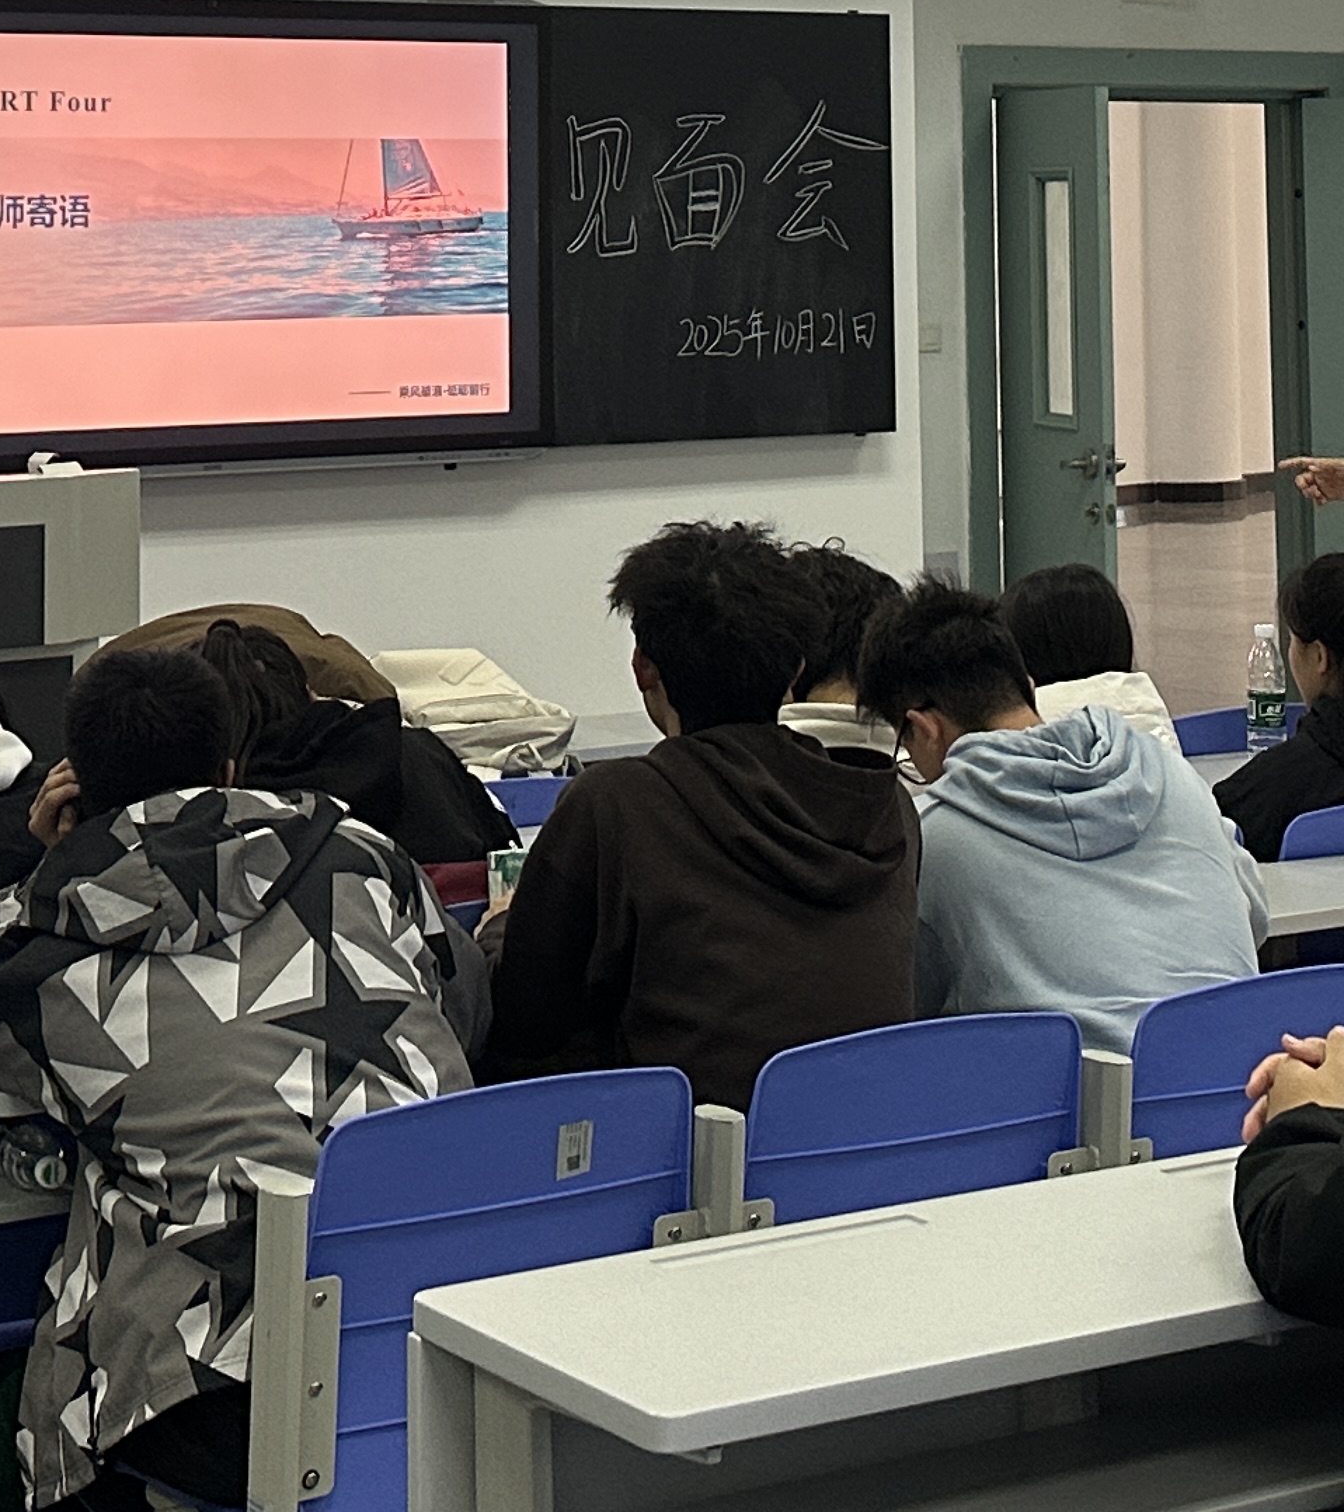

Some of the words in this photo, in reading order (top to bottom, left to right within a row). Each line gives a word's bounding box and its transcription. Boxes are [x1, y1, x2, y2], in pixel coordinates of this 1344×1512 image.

[49, 90, 113, 114] Four
[566, 99, 890, 258] 见面会
[676, 307, 877, 361] 2025年10月21日
